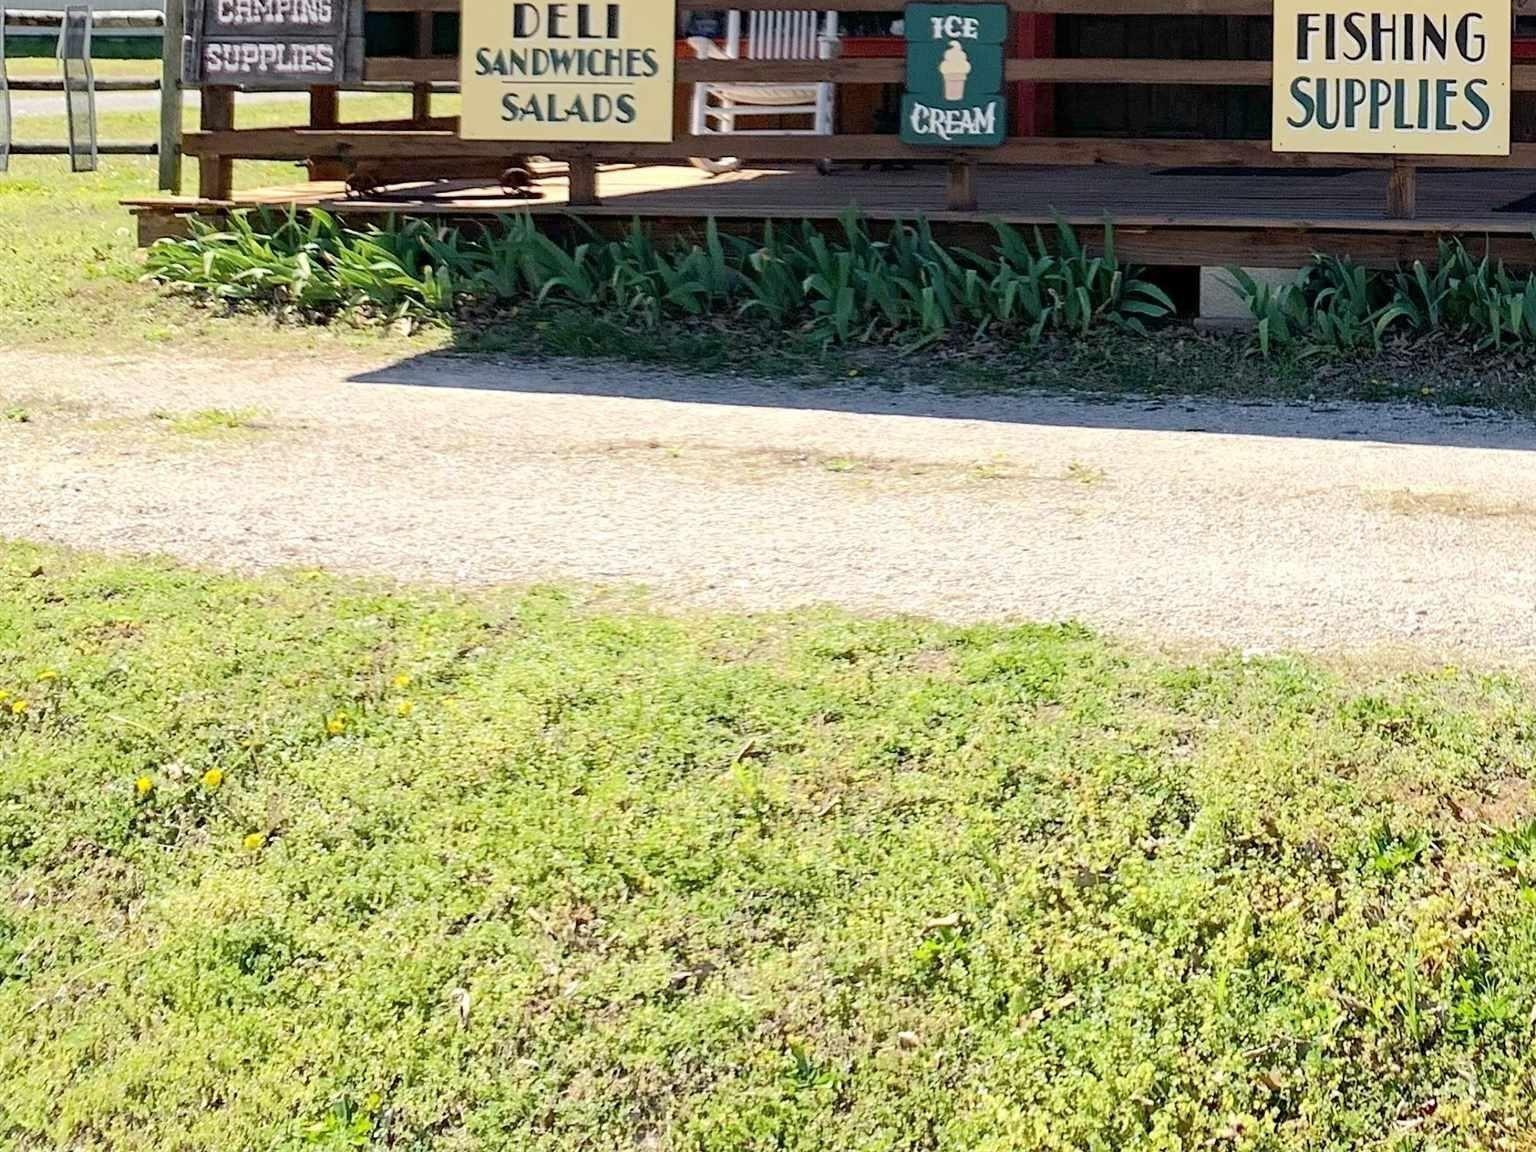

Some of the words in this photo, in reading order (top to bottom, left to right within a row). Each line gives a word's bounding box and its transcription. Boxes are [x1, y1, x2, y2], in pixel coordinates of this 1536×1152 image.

[512, 2, 620, 39] DELI
[930, 15, 979, 40] ICE
[1297, 12, 1486, 62] FISHING
[205, 43, 335, 73] SUPPLIES
[475, 47, 659, 78] SANDWICHES
[501, 92, 637, 124] SALADS
[1286, 76, 1491, 131] SUPPLIES
[910, 102, 997, 141] CREAM
